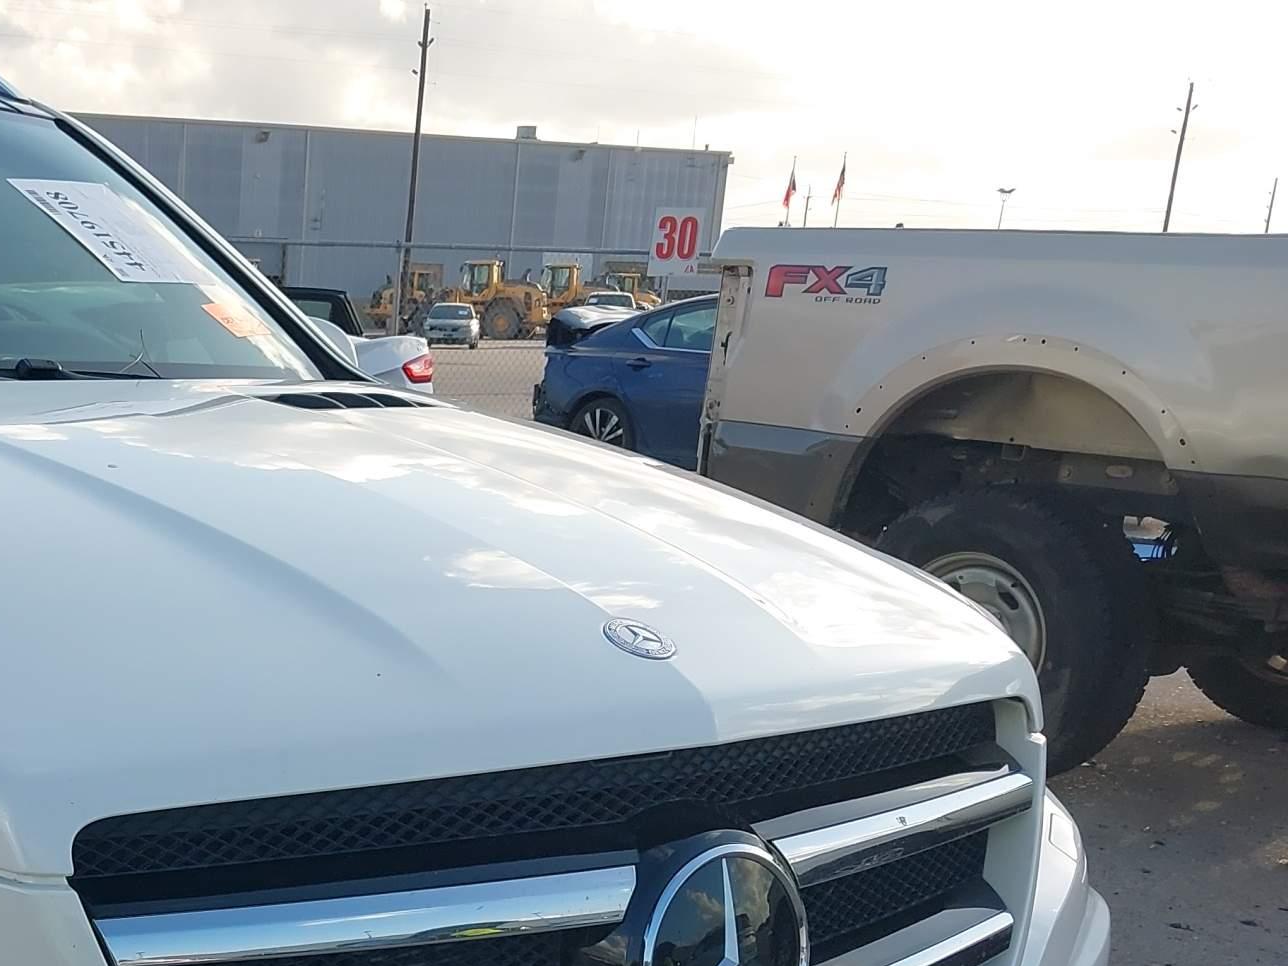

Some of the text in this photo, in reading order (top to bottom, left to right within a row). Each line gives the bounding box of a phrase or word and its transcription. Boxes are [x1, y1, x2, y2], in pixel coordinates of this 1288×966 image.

[46, 190, 145, 272] 44519708
[655, 215, 699, 260] 30
[764, 264, 888, 298] FX4
[845, 296, 881, 304] ROAD
